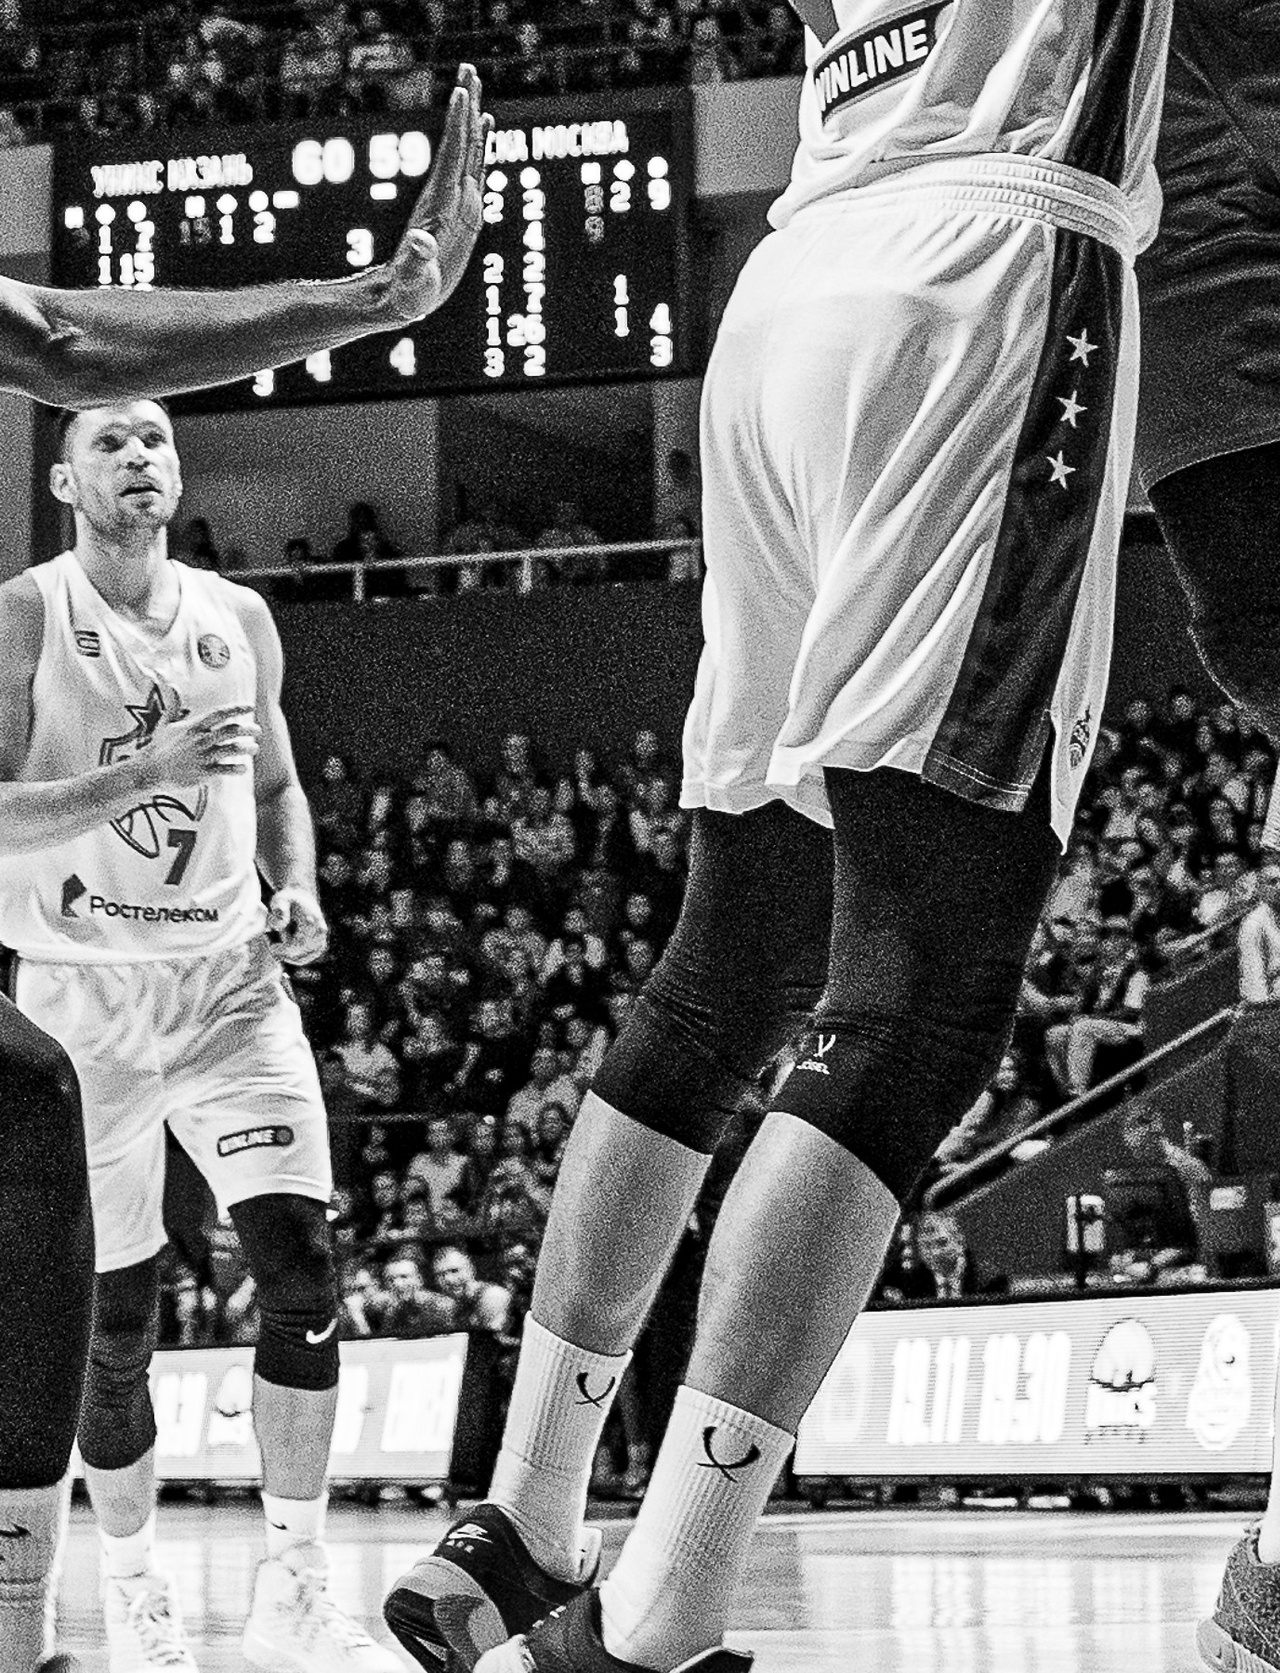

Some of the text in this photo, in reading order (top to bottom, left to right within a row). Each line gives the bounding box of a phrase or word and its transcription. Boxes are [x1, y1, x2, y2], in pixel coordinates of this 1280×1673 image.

[292, 131, 431, 186] 60 59
[346, 228, 375, 267] 3
[163, 828, 198, 886] 7
[89, 895, 219, 923] Ростелеком
